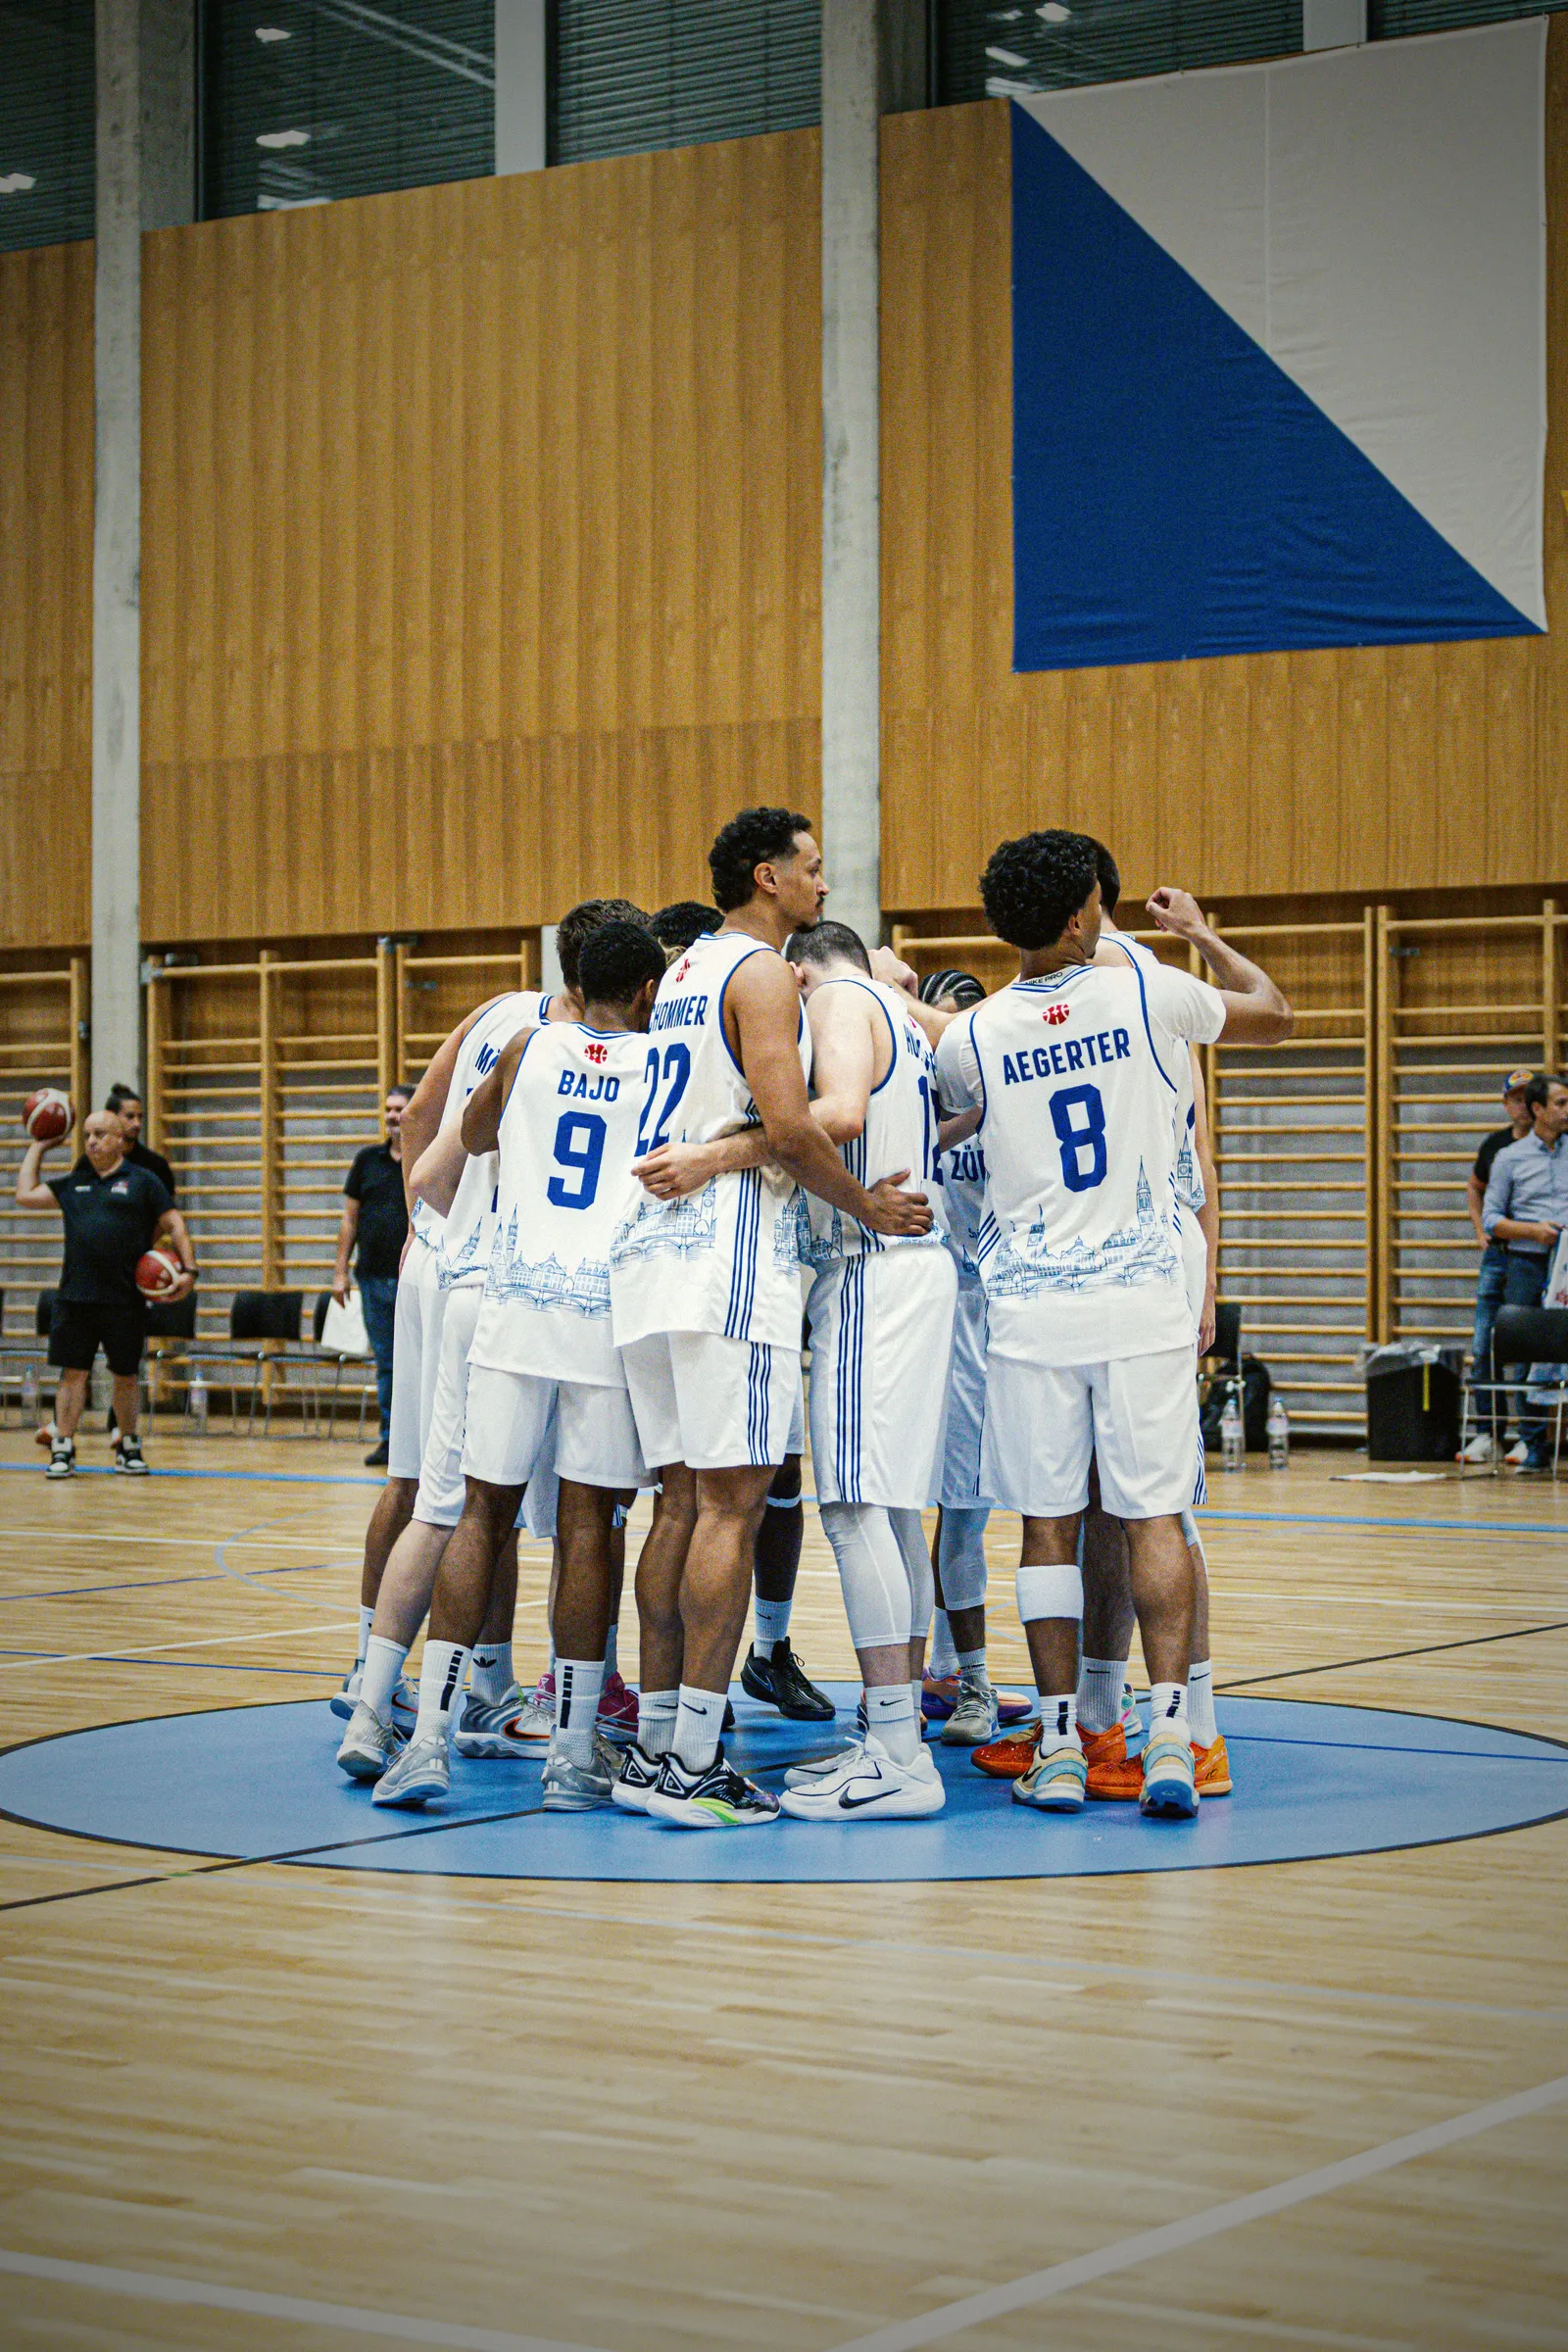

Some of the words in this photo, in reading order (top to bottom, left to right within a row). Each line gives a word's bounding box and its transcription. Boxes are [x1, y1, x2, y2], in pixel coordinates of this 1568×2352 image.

[1045, 971, 1063, 982] PRO
[557, 1069, 620, 1102] BAJO
[1003, 1028, 1131, 1086] AEGERTER
[634, 1043, 691, 1156] 22
[1049, 1083, 1107, 1193] 8
[546, 1110, 608, 1210] 9
